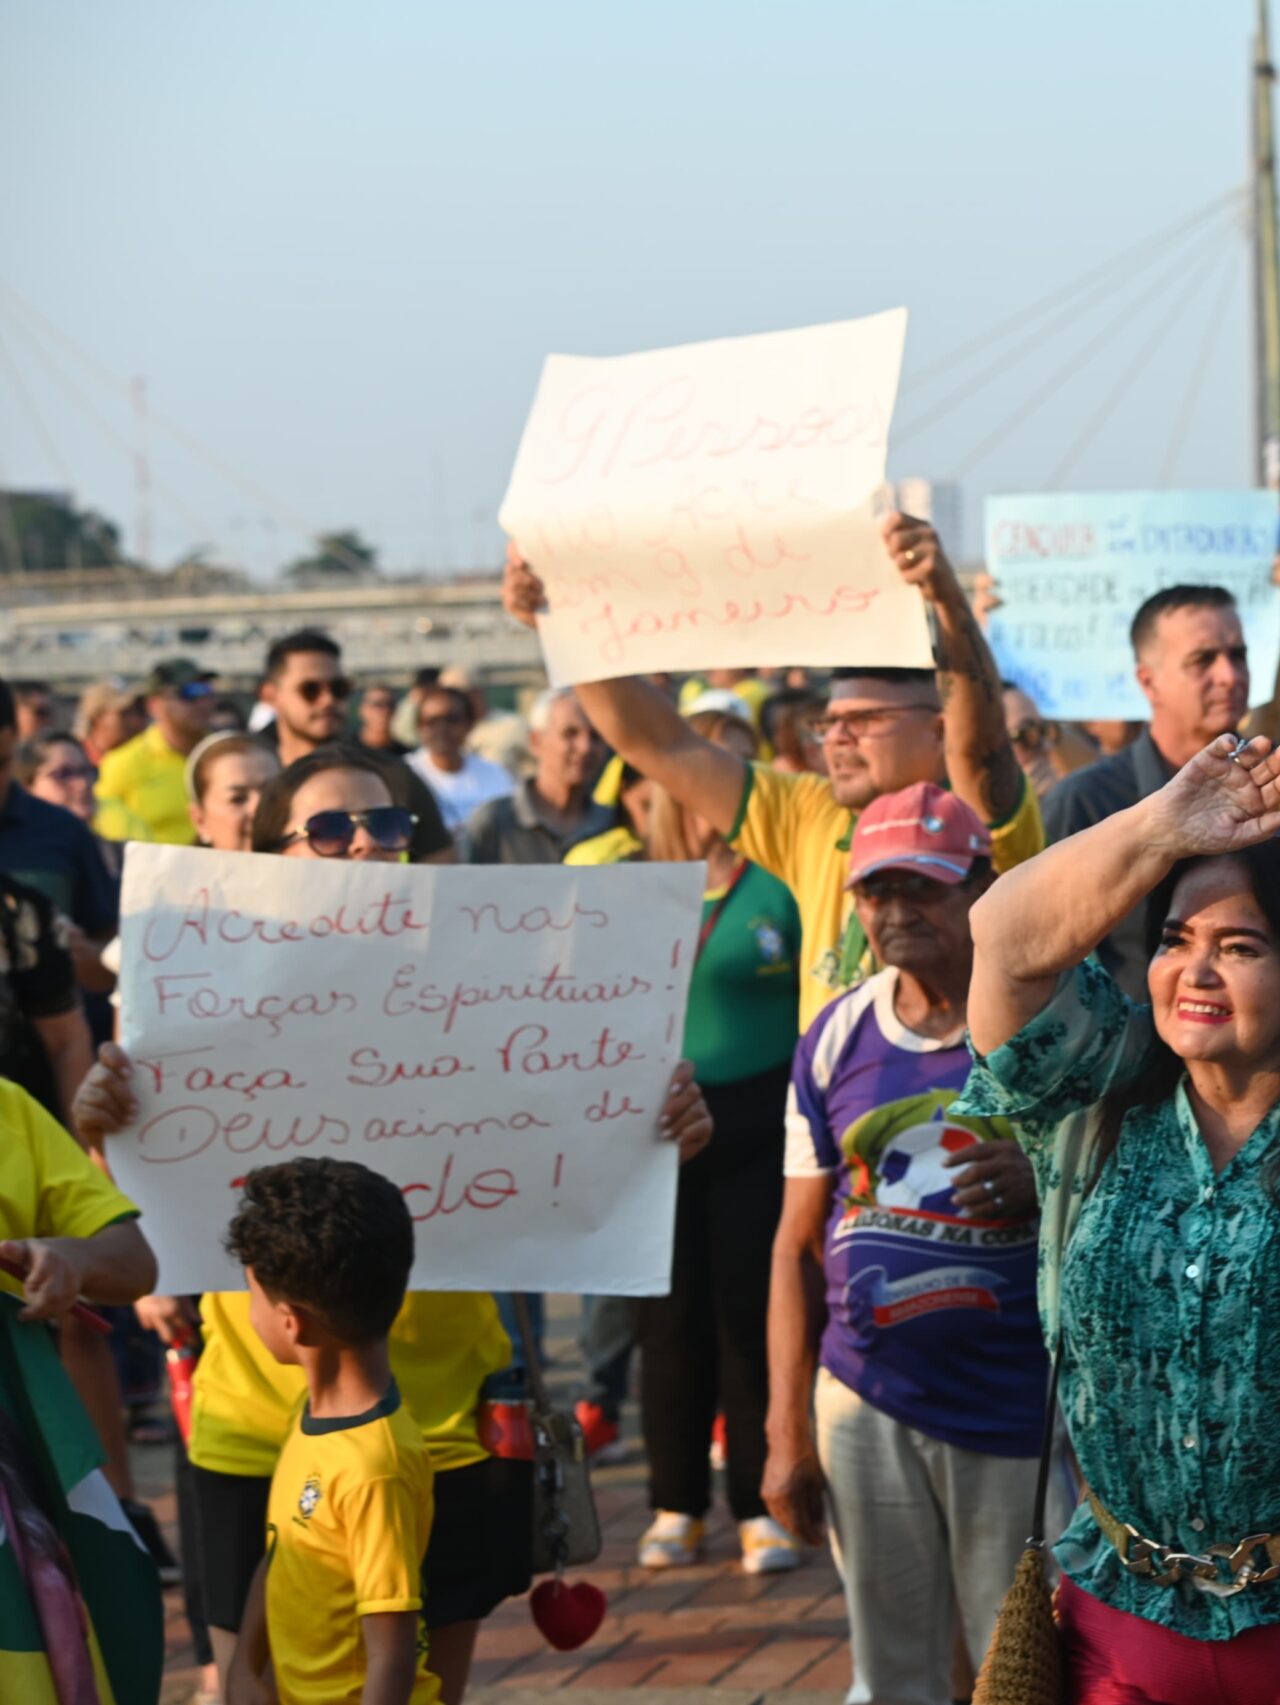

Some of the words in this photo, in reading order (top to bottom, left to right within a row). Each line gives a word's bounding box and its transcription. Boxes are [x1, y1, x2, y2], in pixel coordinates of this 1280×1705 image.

[141, 887, 427, 962] Acredite
[460, 902, 611, 935] nas
[152, 972, 359, 1037] Forças
[135, 1046, 308, 1101] Faça
[347, 1047, 476, 1087] Sua
[585, 1090, 645, 1124] de
